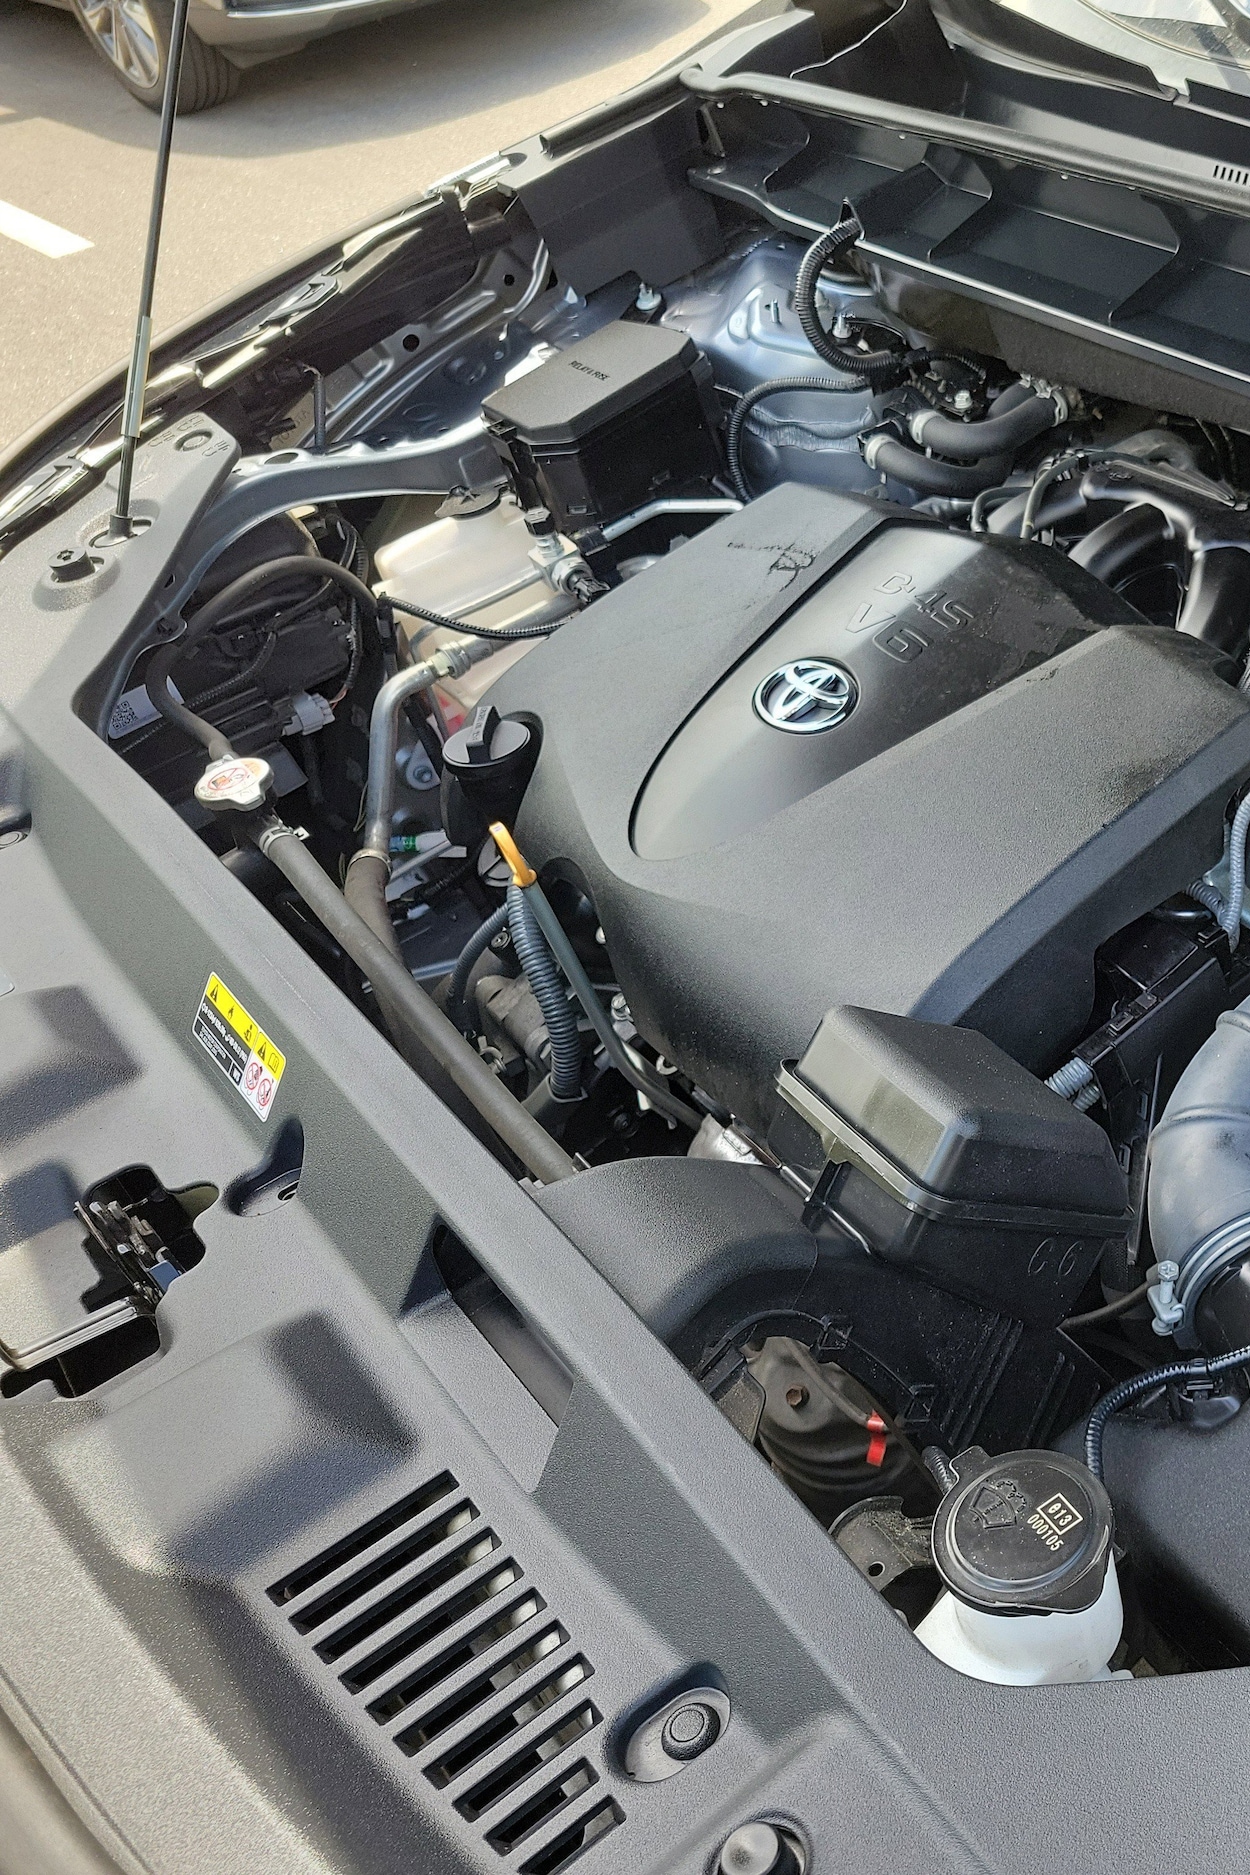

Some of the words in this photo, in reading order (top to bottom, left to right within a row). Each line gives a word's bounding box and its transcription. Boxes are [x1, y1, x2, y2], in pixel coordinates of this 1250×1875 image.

[845, 602, 934, 664] V6
[1027, 1514, 1064, 1552] 000105
[1048, 1502, 1071, 1527] e13
